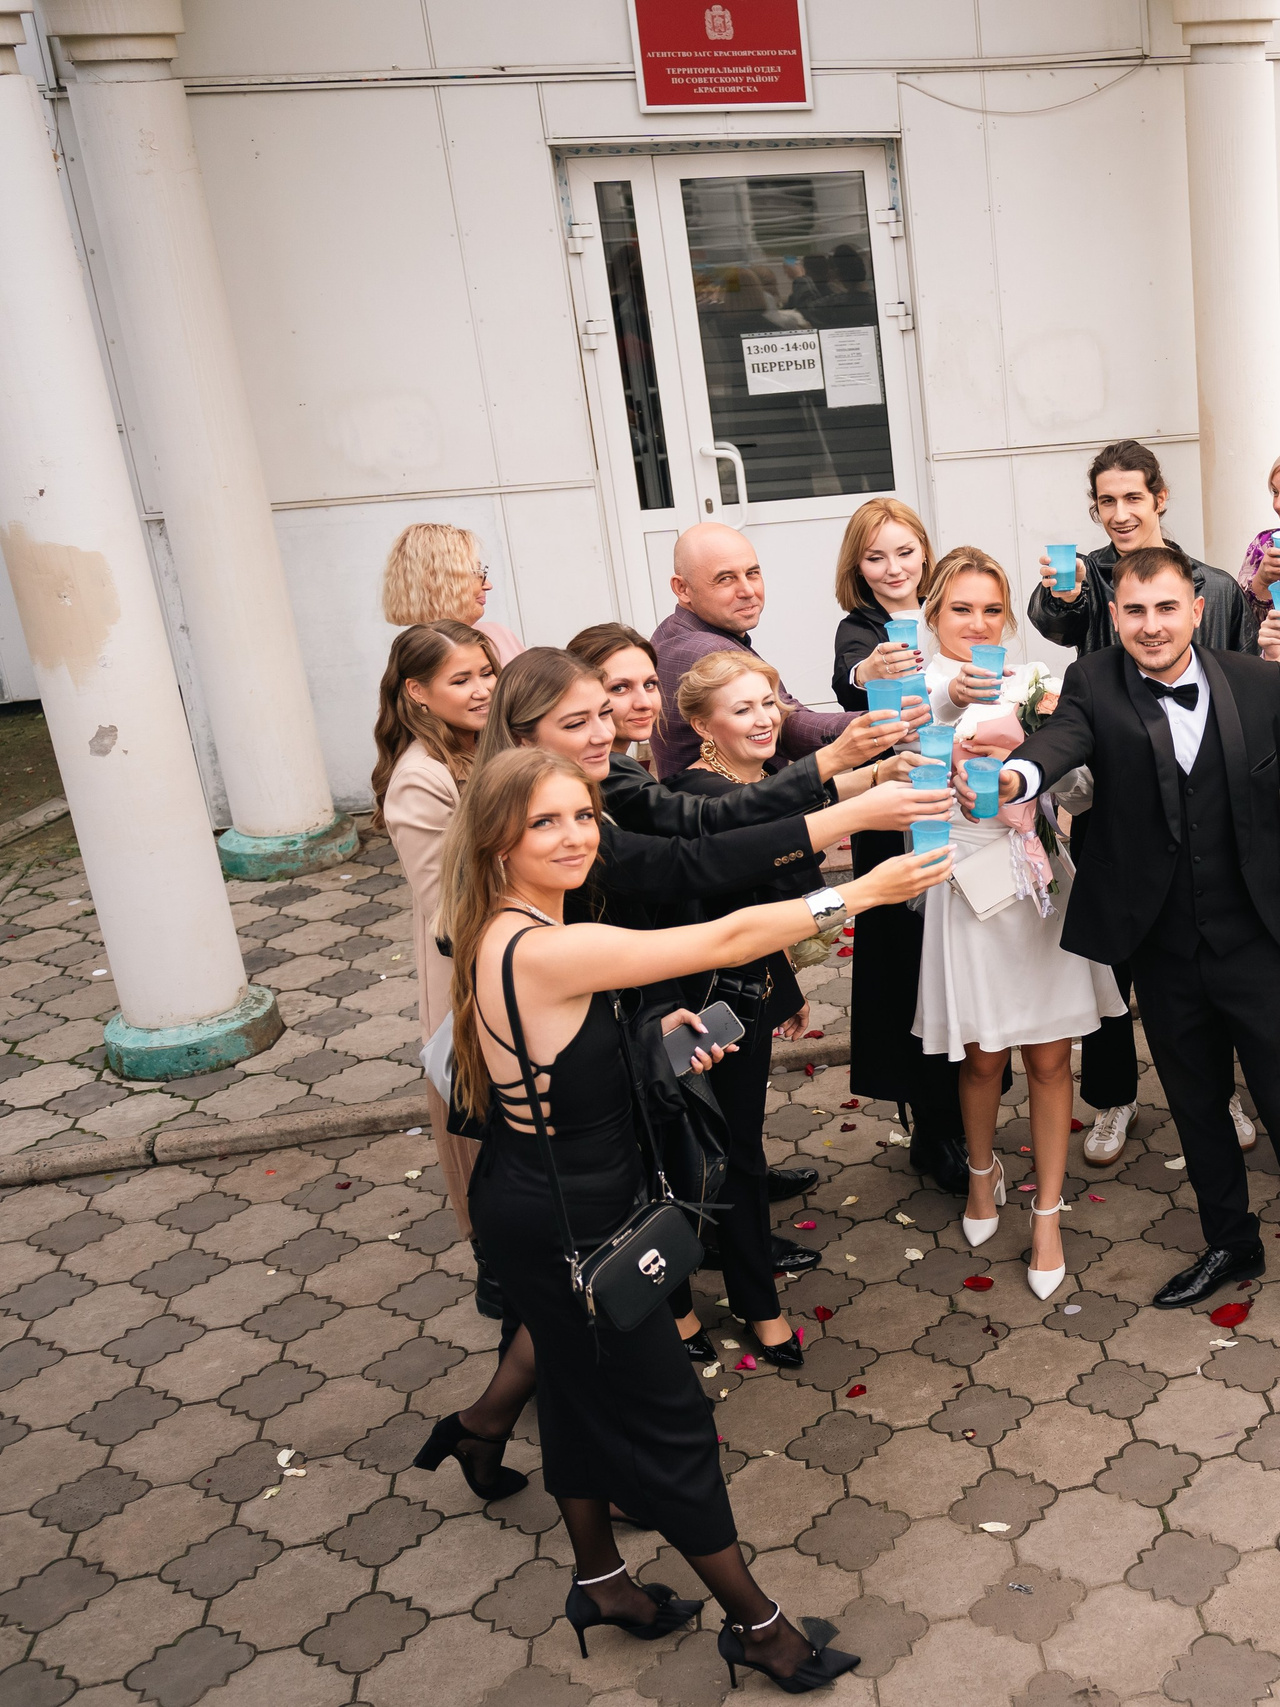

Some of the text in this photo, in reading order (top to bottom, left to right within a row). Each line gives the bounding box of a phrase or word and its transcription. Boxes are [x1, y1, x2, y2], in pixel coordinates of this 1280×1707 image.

[665, 65, 752, 74] ТЕРРИТОРИАЛЬНЫЙ
[685, 76, 744, 84] СОВЕТСКОМУ
[746, 75, 780, 83] РАЙОНУ
[693, 86, 758, 94] г.КРАСНОЯРСКА
[746, 343, 778, 356] 13:00
[751, 358, 816, 374] ПЕРЕРЫВ
